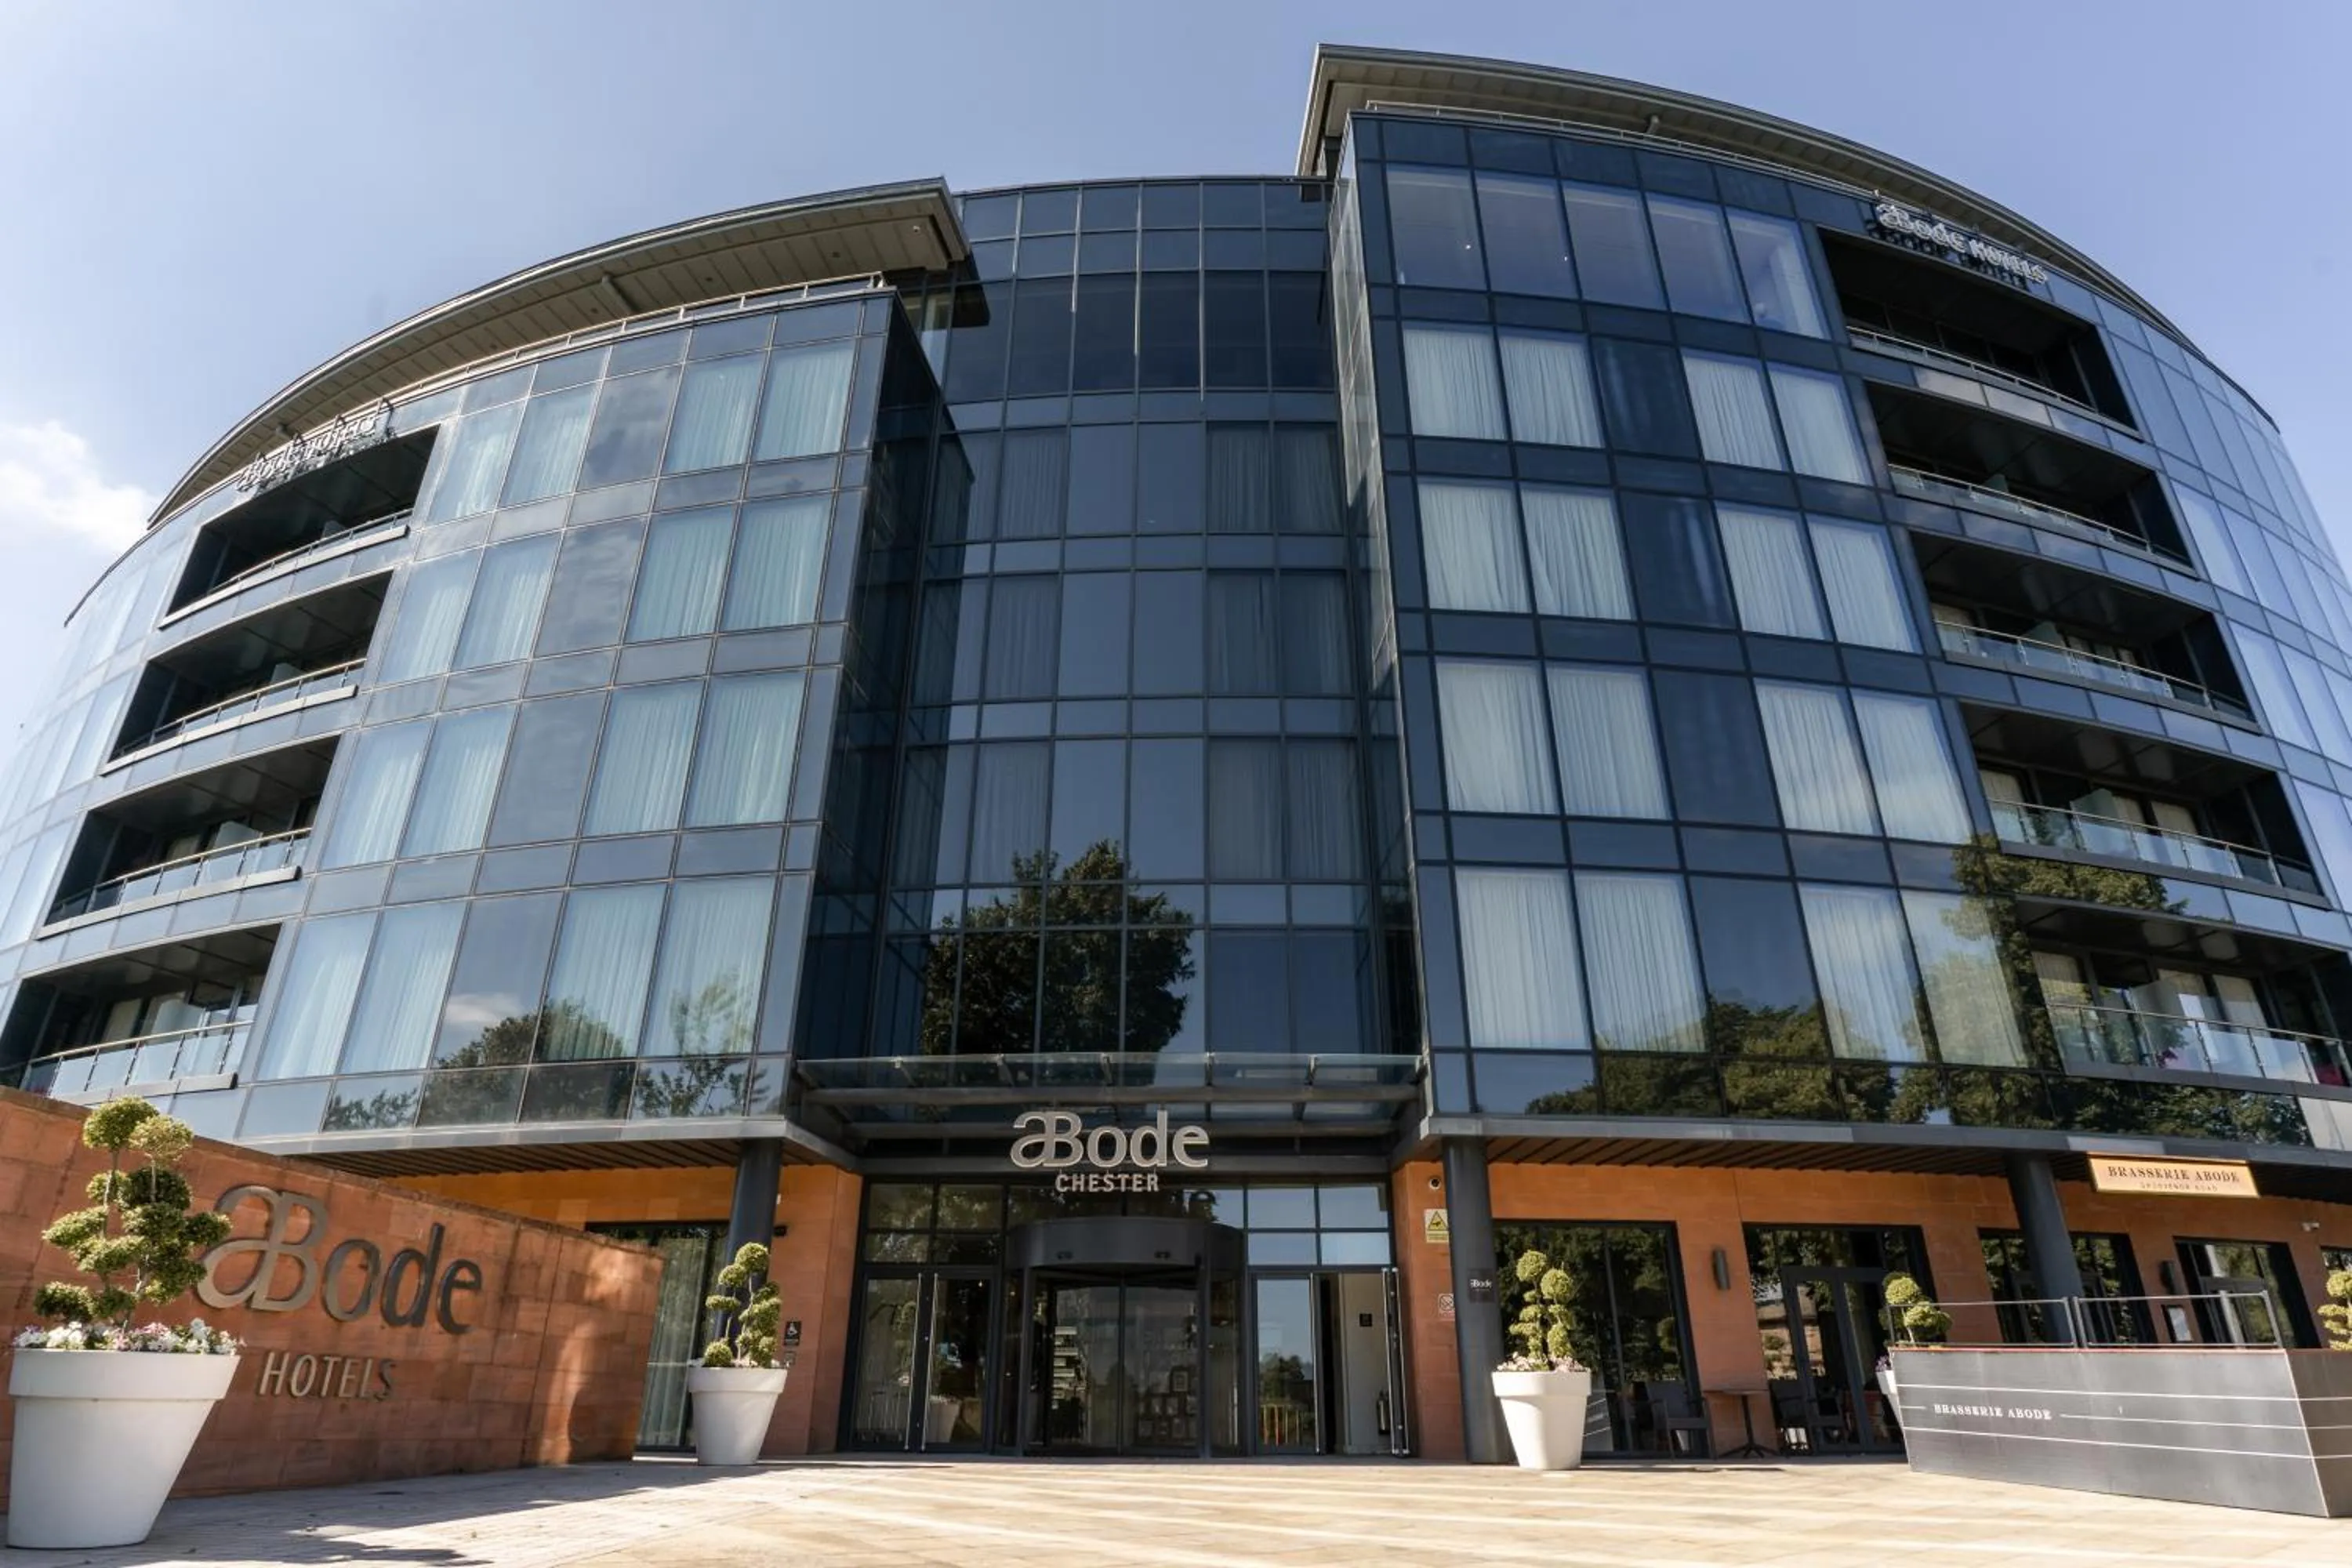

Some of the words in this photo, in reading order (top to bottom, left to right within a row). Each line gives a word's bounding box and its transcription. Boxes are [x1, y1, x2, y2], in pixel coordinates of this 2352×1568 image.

[1054, 1173, 1160, 1193] CHESTER
[2108, 1165, 2190, 1181] BRASSERIE
[2194, 1170, 2241, 1183] ABODE
[258, 1351, 397, 1401] HOTELS
[1933, 1404, 2003, 1417] BRASSERIE
[2008, 1408, 2053, 1421] ABODE
